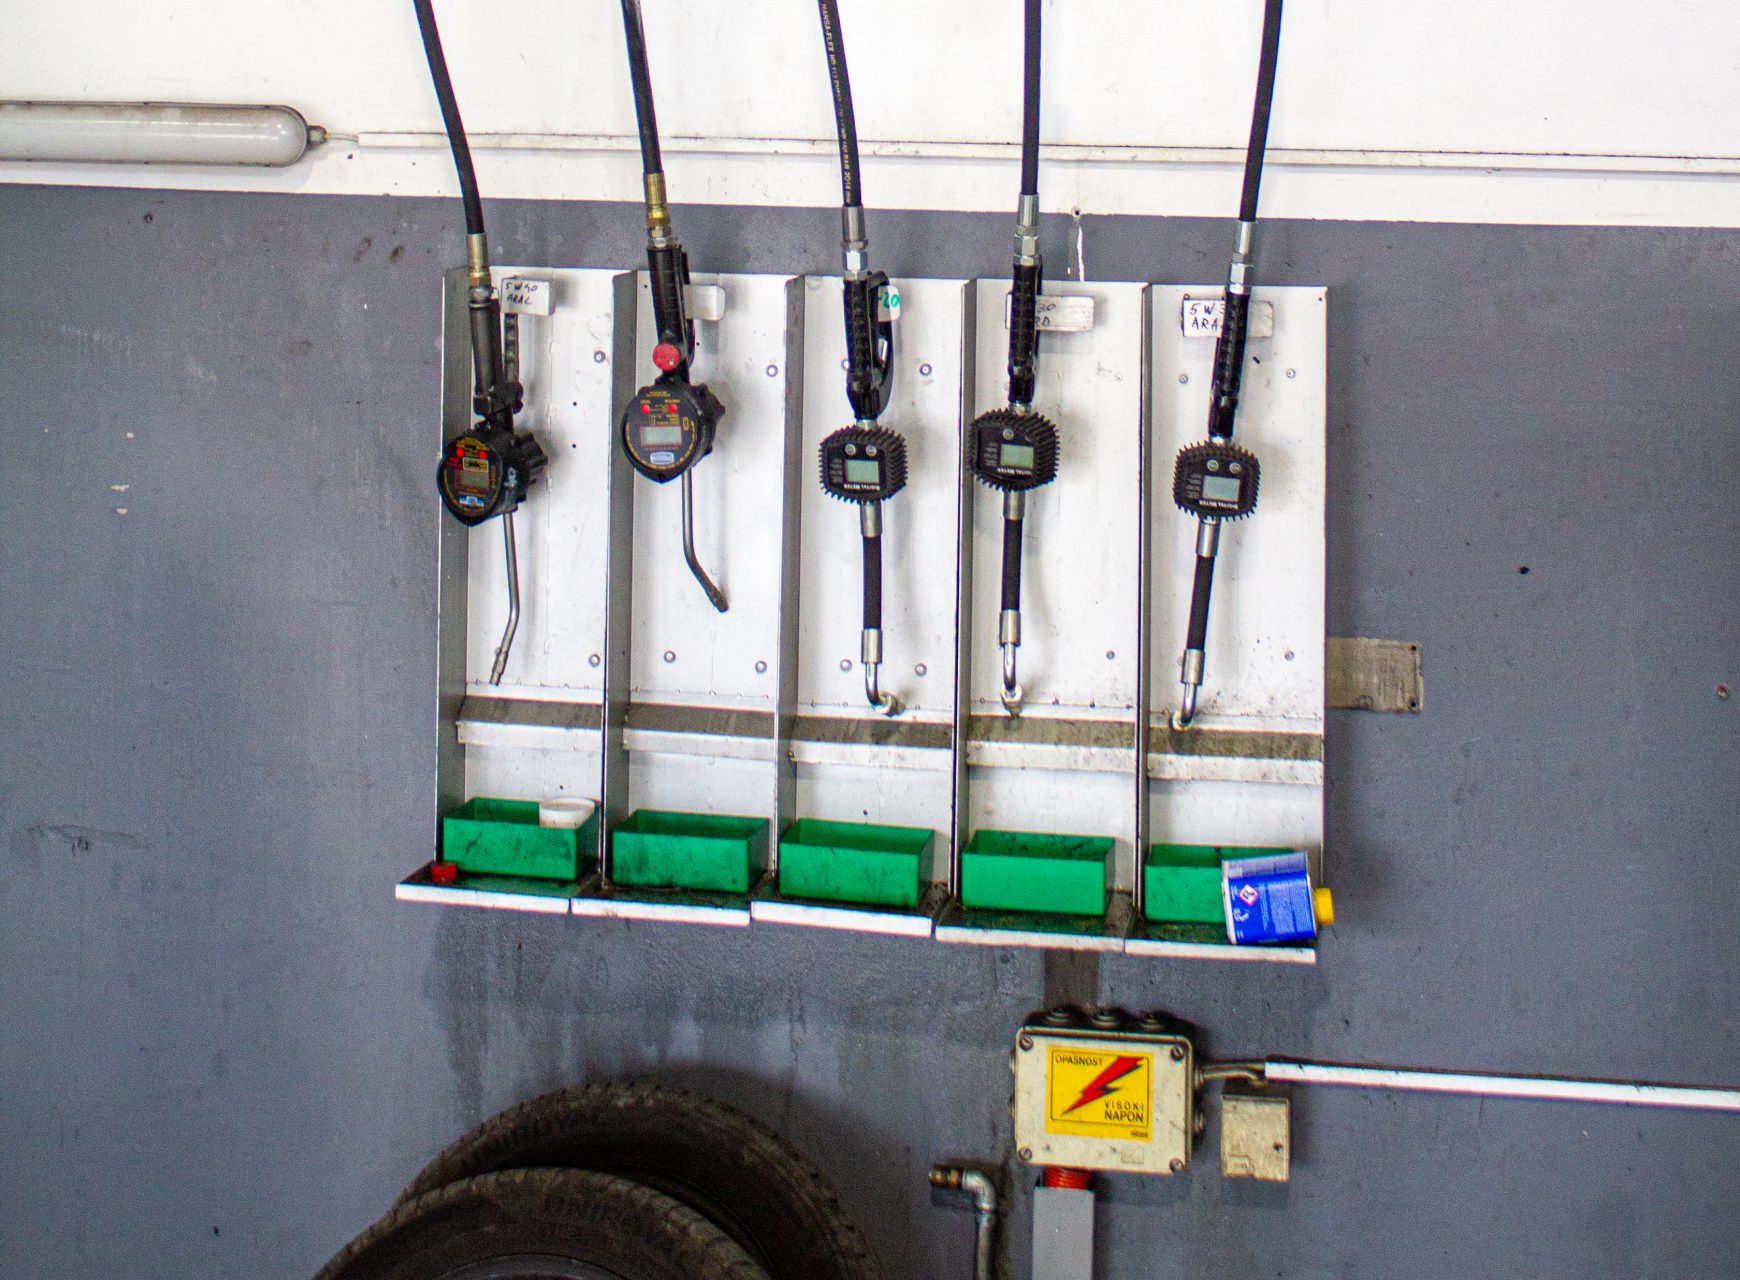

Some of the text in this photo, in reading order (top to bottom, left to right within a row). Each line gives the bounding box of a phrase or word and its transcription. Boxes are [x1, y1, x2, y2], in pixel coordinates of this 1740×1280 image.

[821, 3, 834, 52] HANSA-FLEX
[1055, 1054, 1103, 1066] OPASNOST
[1103, 1100, 1145, 1112] VISOKI
[1104, 1109, 1144, 1123] NAPON
